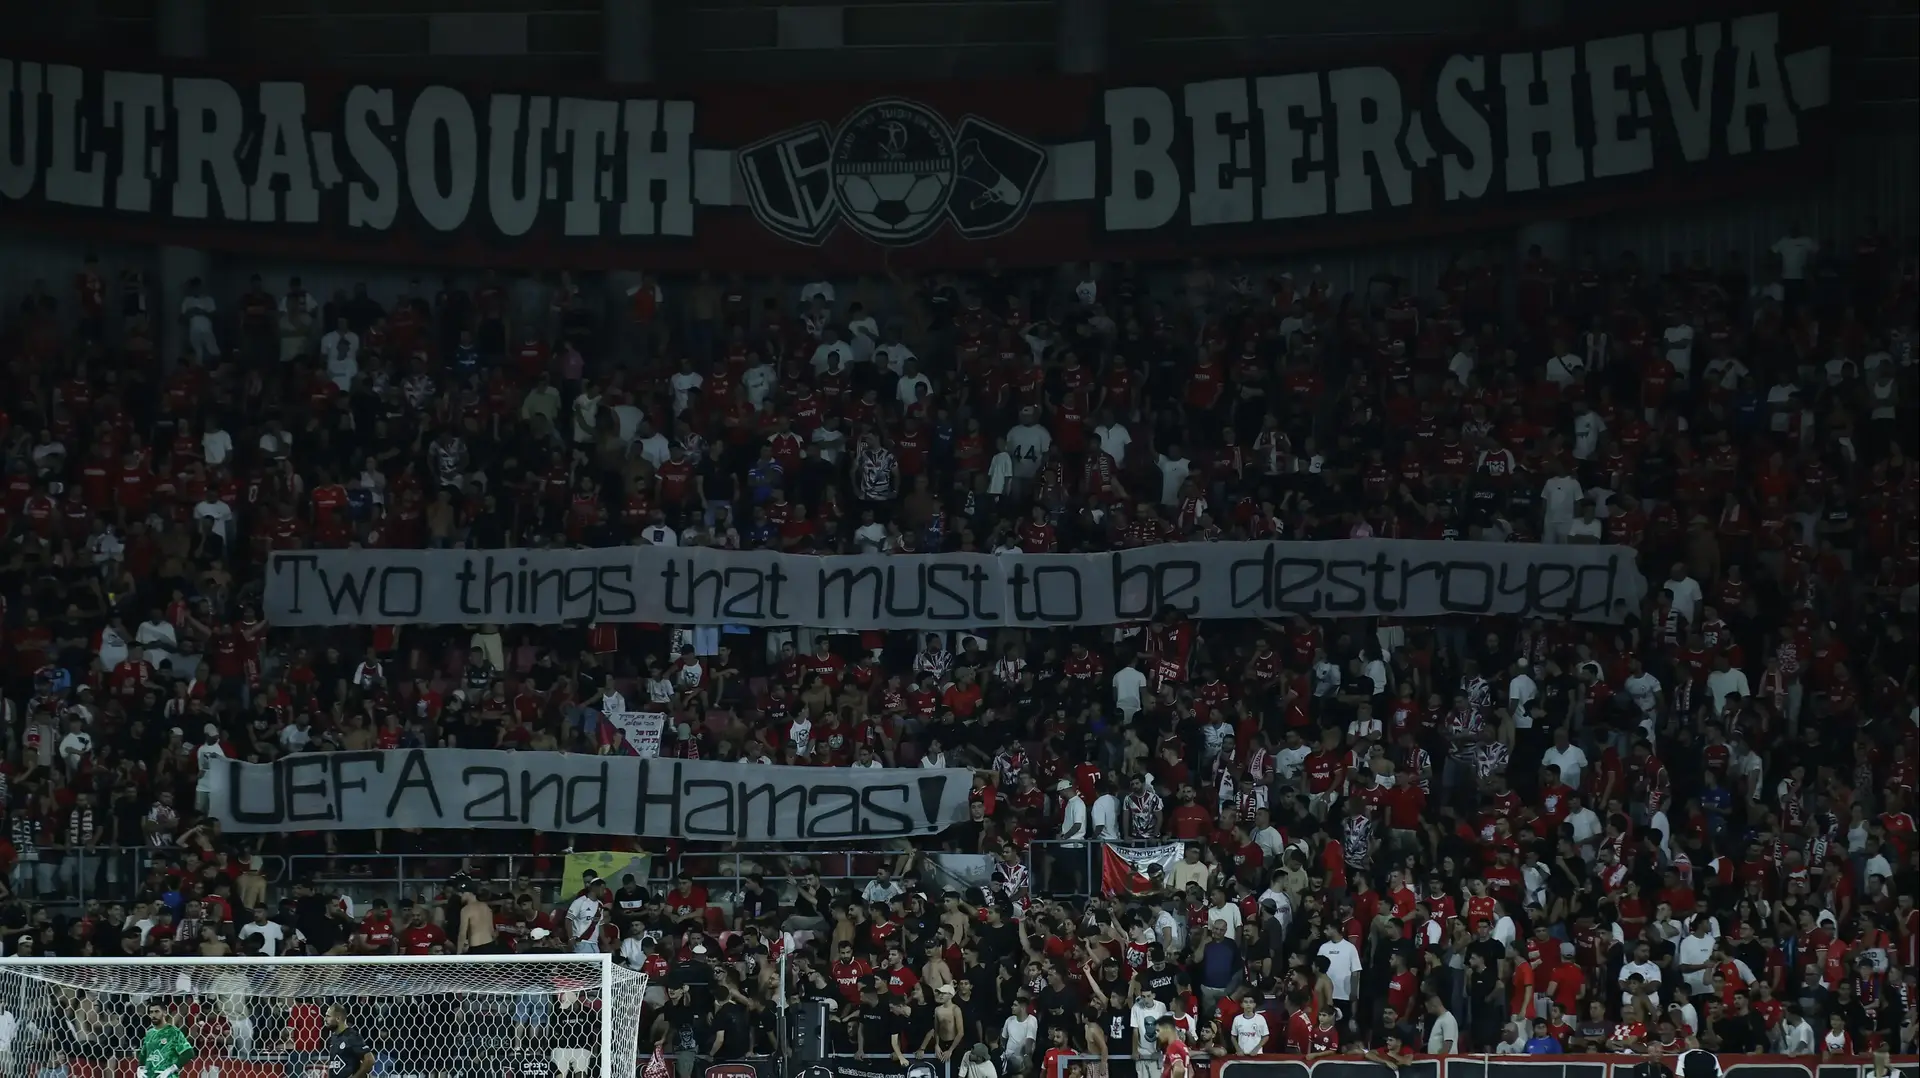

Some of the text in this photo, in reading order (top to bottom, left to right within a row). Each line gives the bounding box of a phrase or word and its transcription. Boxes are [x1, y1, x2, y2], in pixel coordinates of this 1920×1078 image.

[0, 58, 695, 236] ULTRA SOUTH
[1104, 11, 1800, 231] BEER SHEVA
[1013, 444, 1038, 463] 44
[273, 543, 1627, 622] Two things that must to be destroyed.
[229, 748, 947, 839] UEFA and Hamas!
